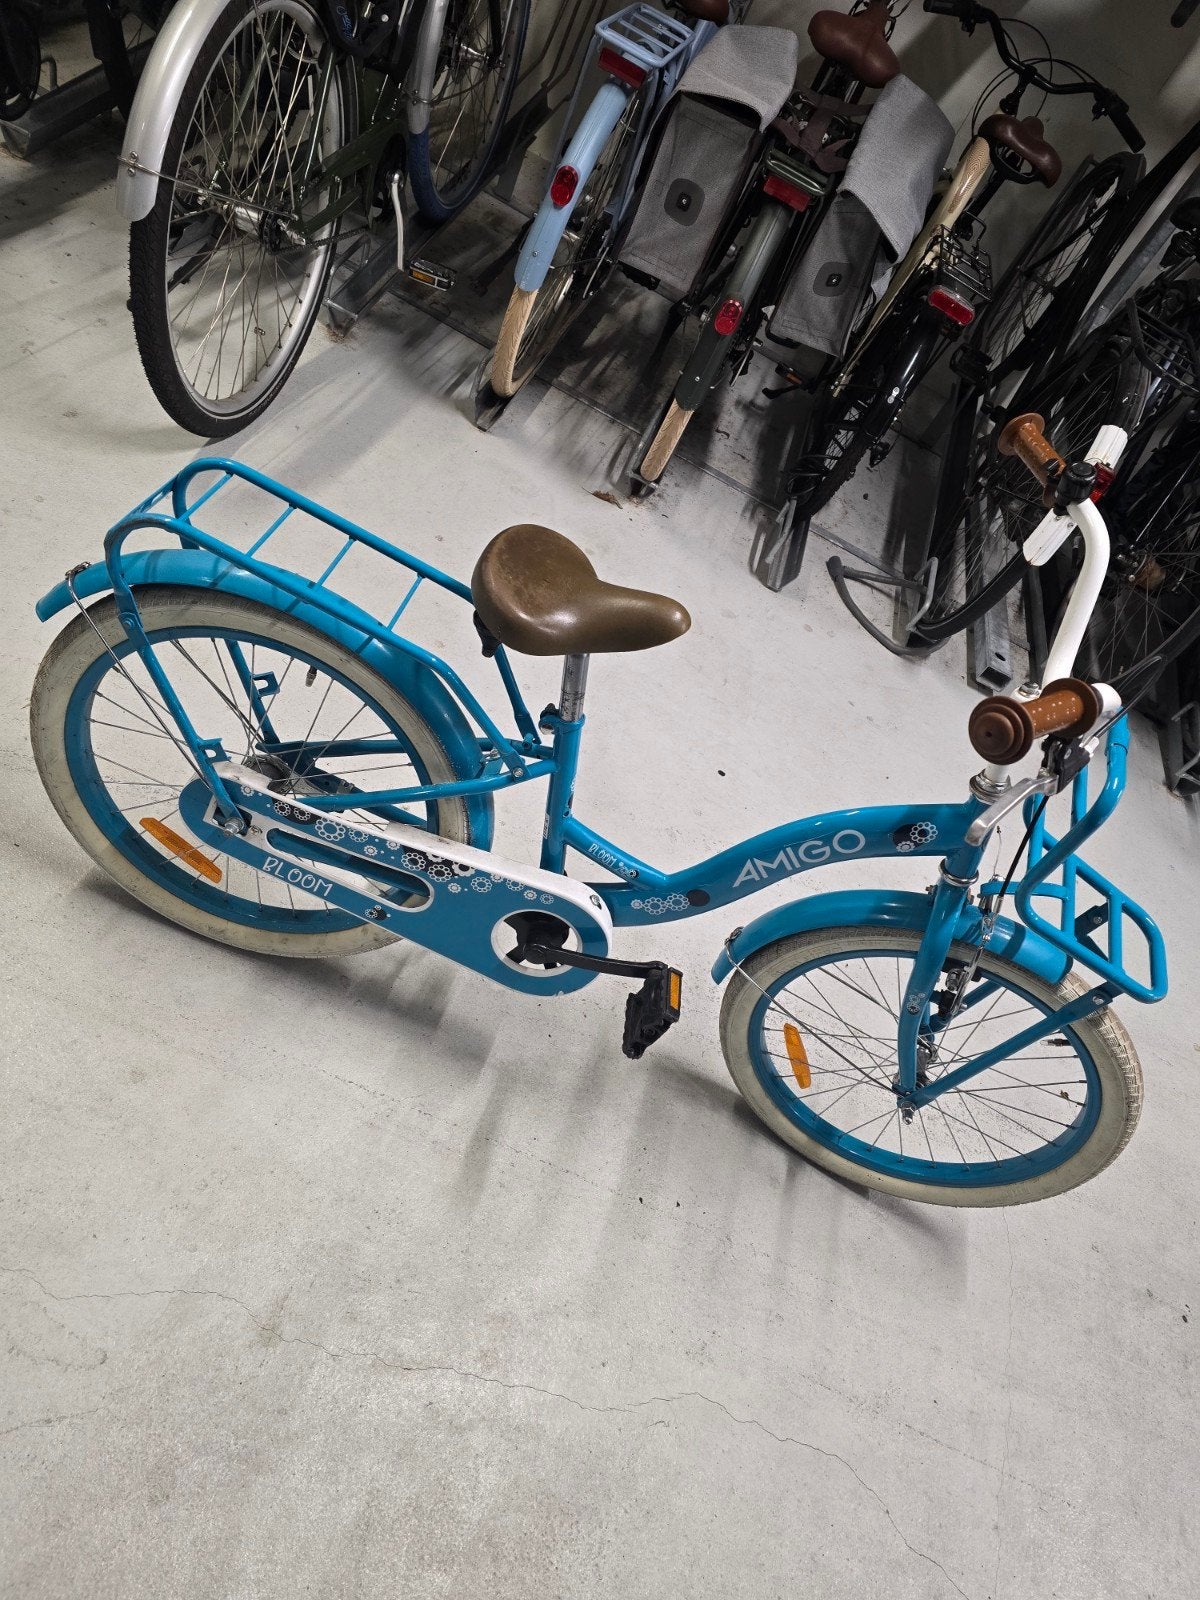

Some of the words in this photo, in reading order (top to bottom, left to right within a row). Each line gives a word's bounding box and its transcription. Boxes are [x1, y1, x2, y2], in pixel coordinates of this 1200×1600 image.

[588, 843, 617, 867] BLOOM
[732, 829, 866, 888] AMIGO
[262, 856, 333, 897] BLOOM
